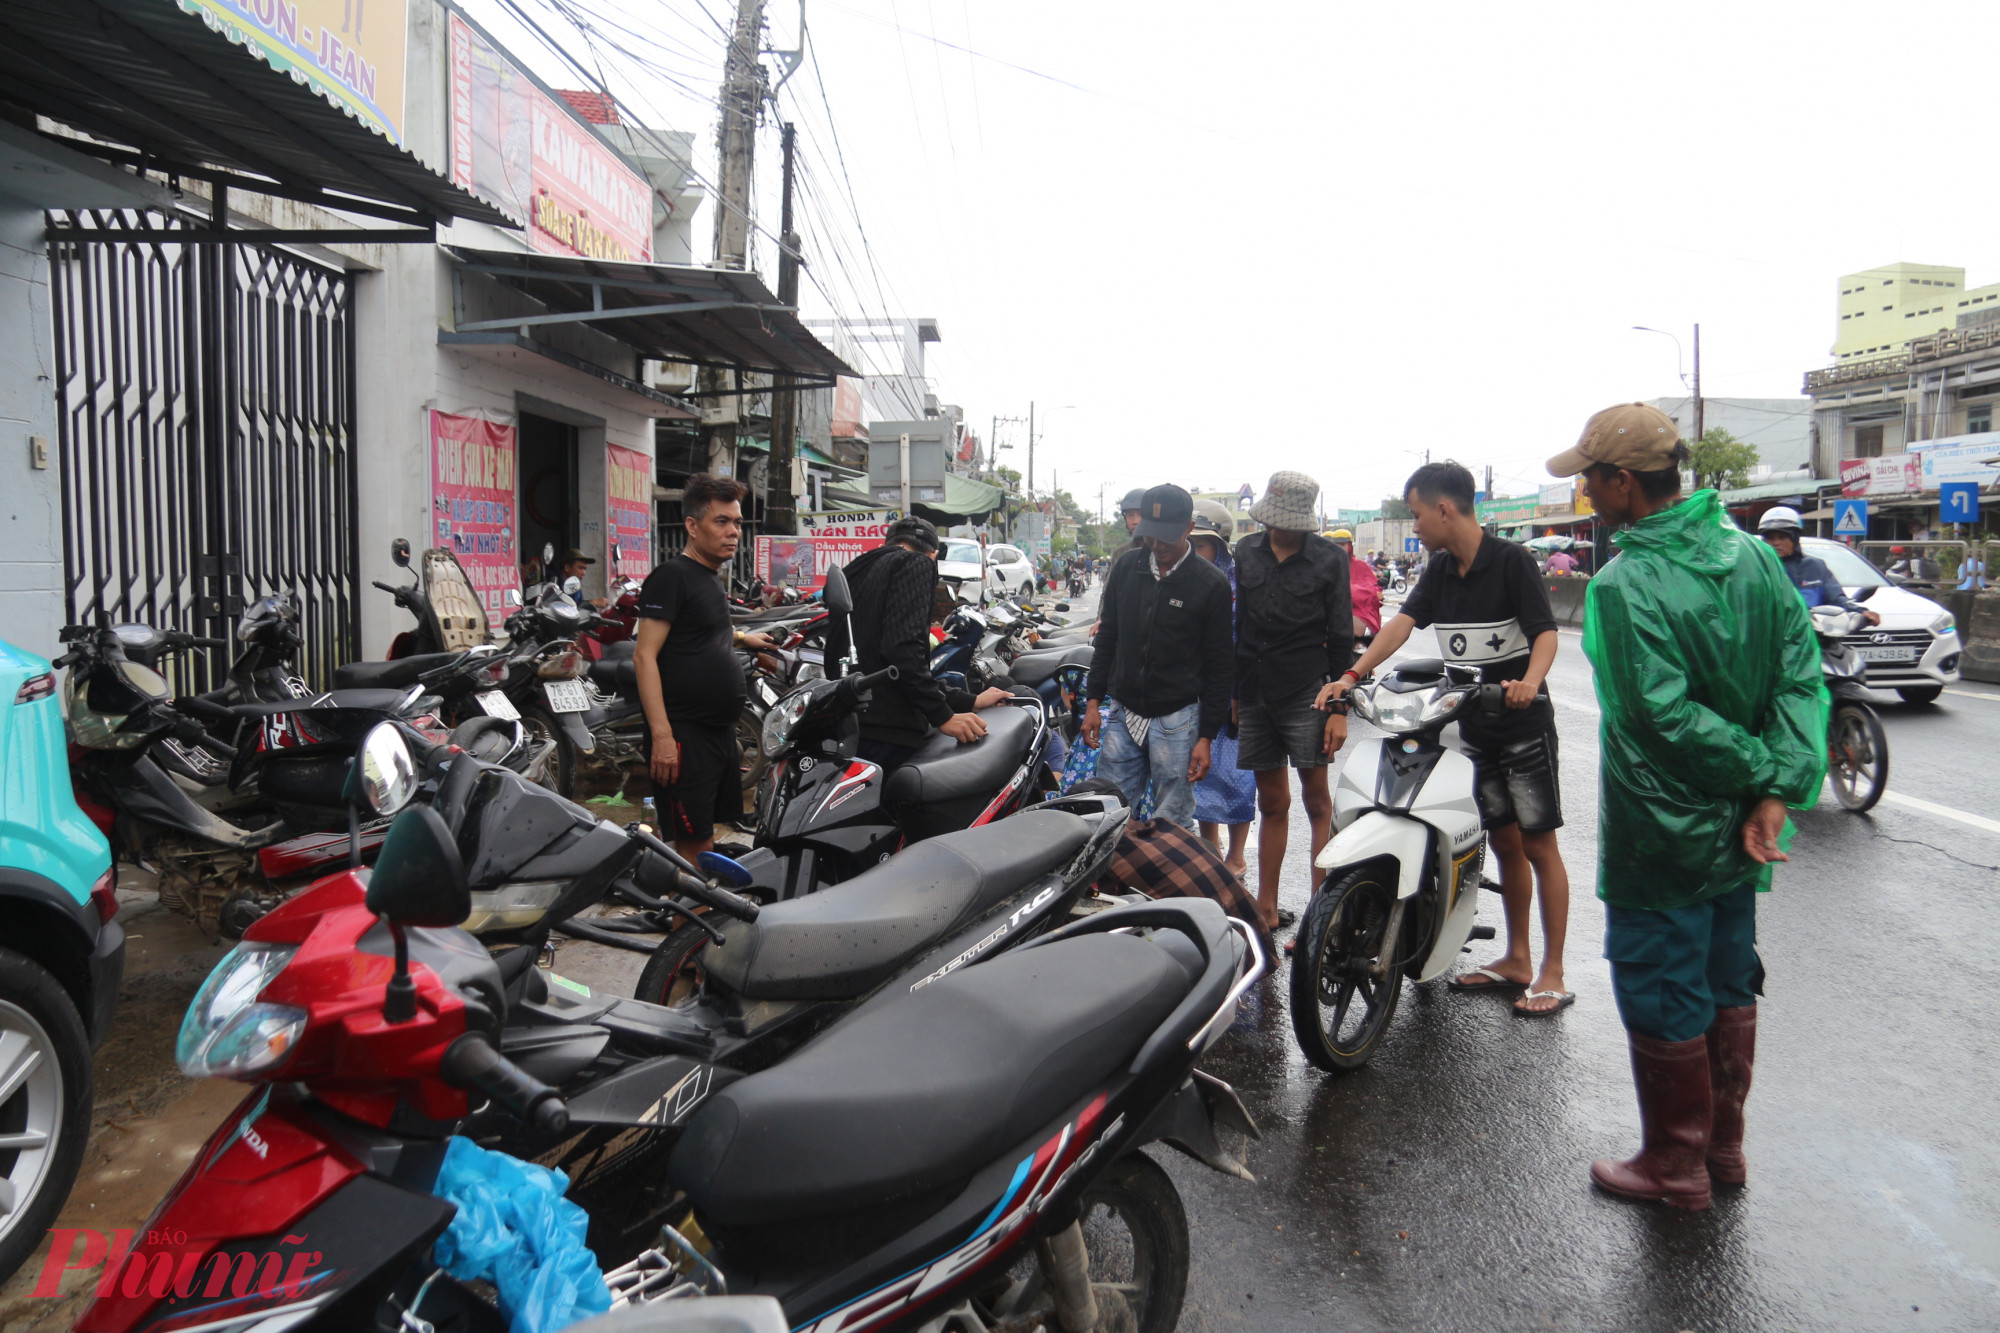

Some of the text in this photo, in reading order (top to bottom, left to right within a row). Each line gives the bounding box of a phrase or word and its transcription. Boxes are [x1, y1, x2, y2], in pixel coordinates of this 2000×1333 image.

[317, 26, 377, 104] JEAN
[532, 103, 649, 237] KAWAMATSU
[826, 512, 875, 524] HONDA
[1859, 650, 1909, 660] 7A-439.64
[550, 684, 578, 697] 78-G1
[553, 696, 586, 710] 645.93
[1454, 823, 1479, 846] YAMAHA
[910, 887, 1055, 993] EXCITER RC
